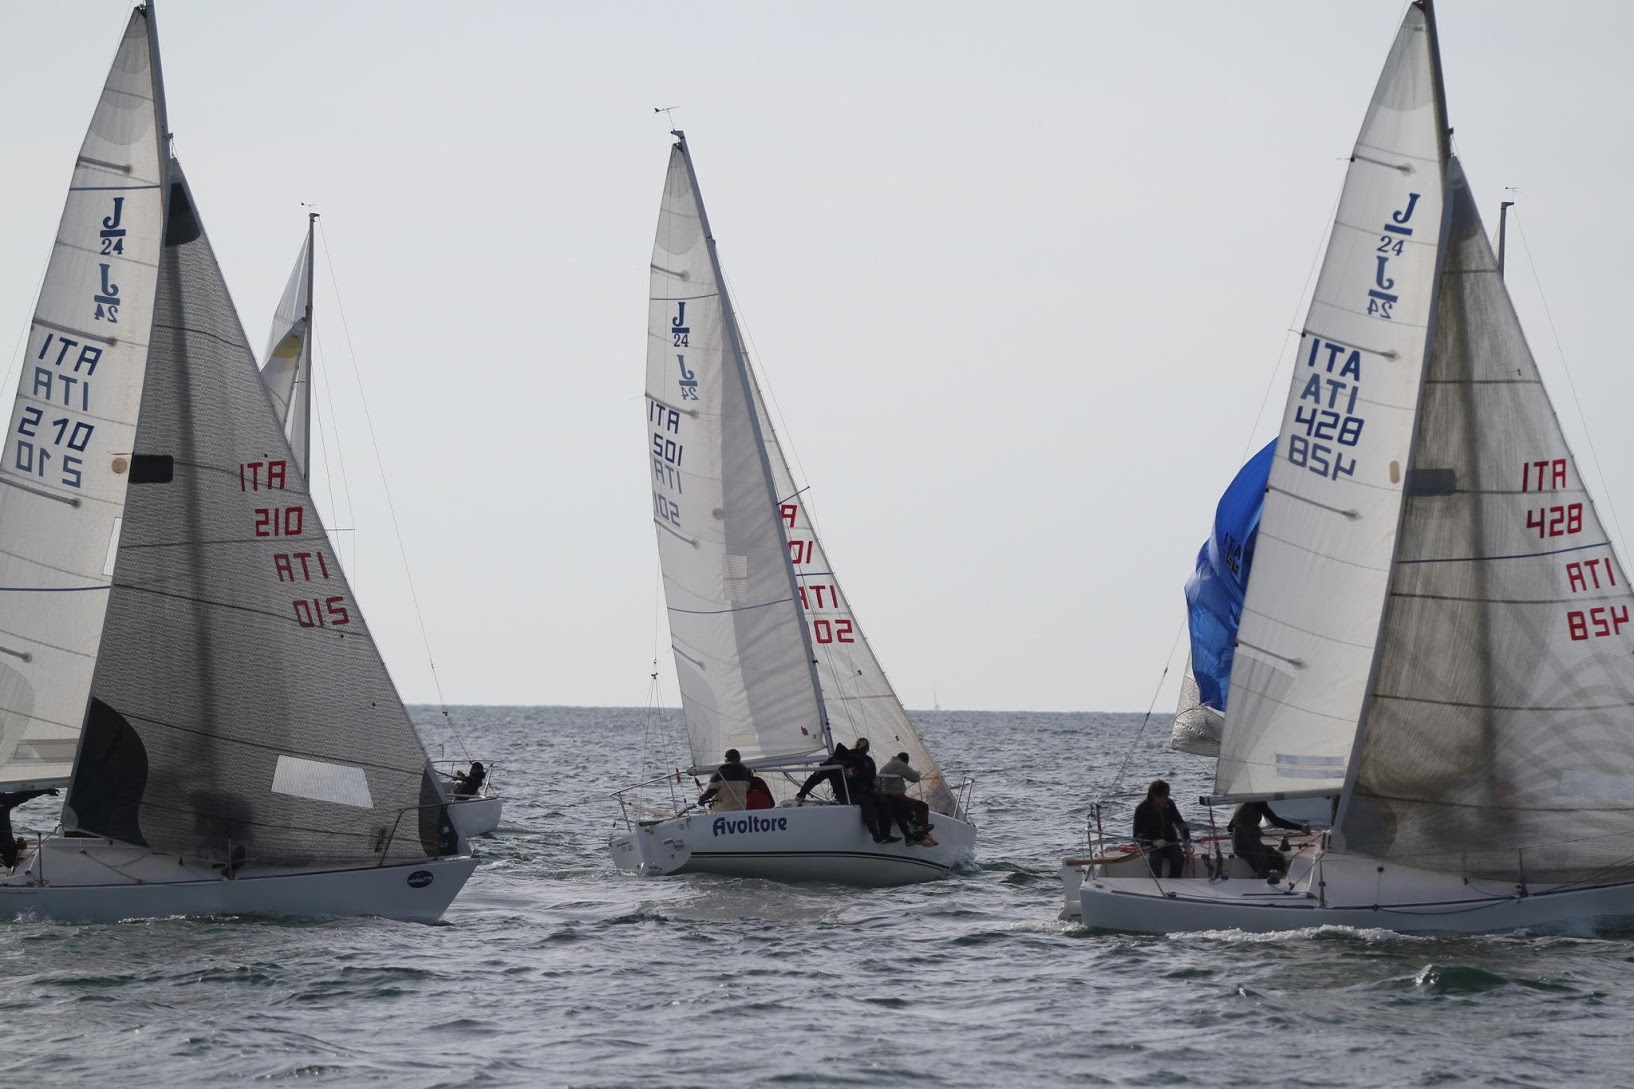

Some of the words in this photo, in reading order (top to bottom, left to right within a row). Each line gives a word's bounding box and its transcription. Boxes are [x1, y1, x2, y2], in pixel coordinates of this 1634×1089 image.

[102, 197, 125, 230] J
[1392, 192, 1421, 225] J
[100, 237, 124, 256] 24
[1376, 235, 1405, 257] 24
[672, 301, 687, 327] J
[38, 333, 103, 376] ITA
[673, 333, 689, 348] 24
[1308, 338, 1361, 382] ITA
[17, 406, 95, 452] 210
[649, 400, 681, 434] ITA
[1294, 405, 1365, 447] 428
[240, 460, 286, 492] ITA
[1522, 458, 1566, 493] ITA
[255, 506, 303, 537] 210
[1526, 502, 1583, 539] 428
[787, 540, 813, 564] 01
[712, 816, 787, 837] Avoltore
